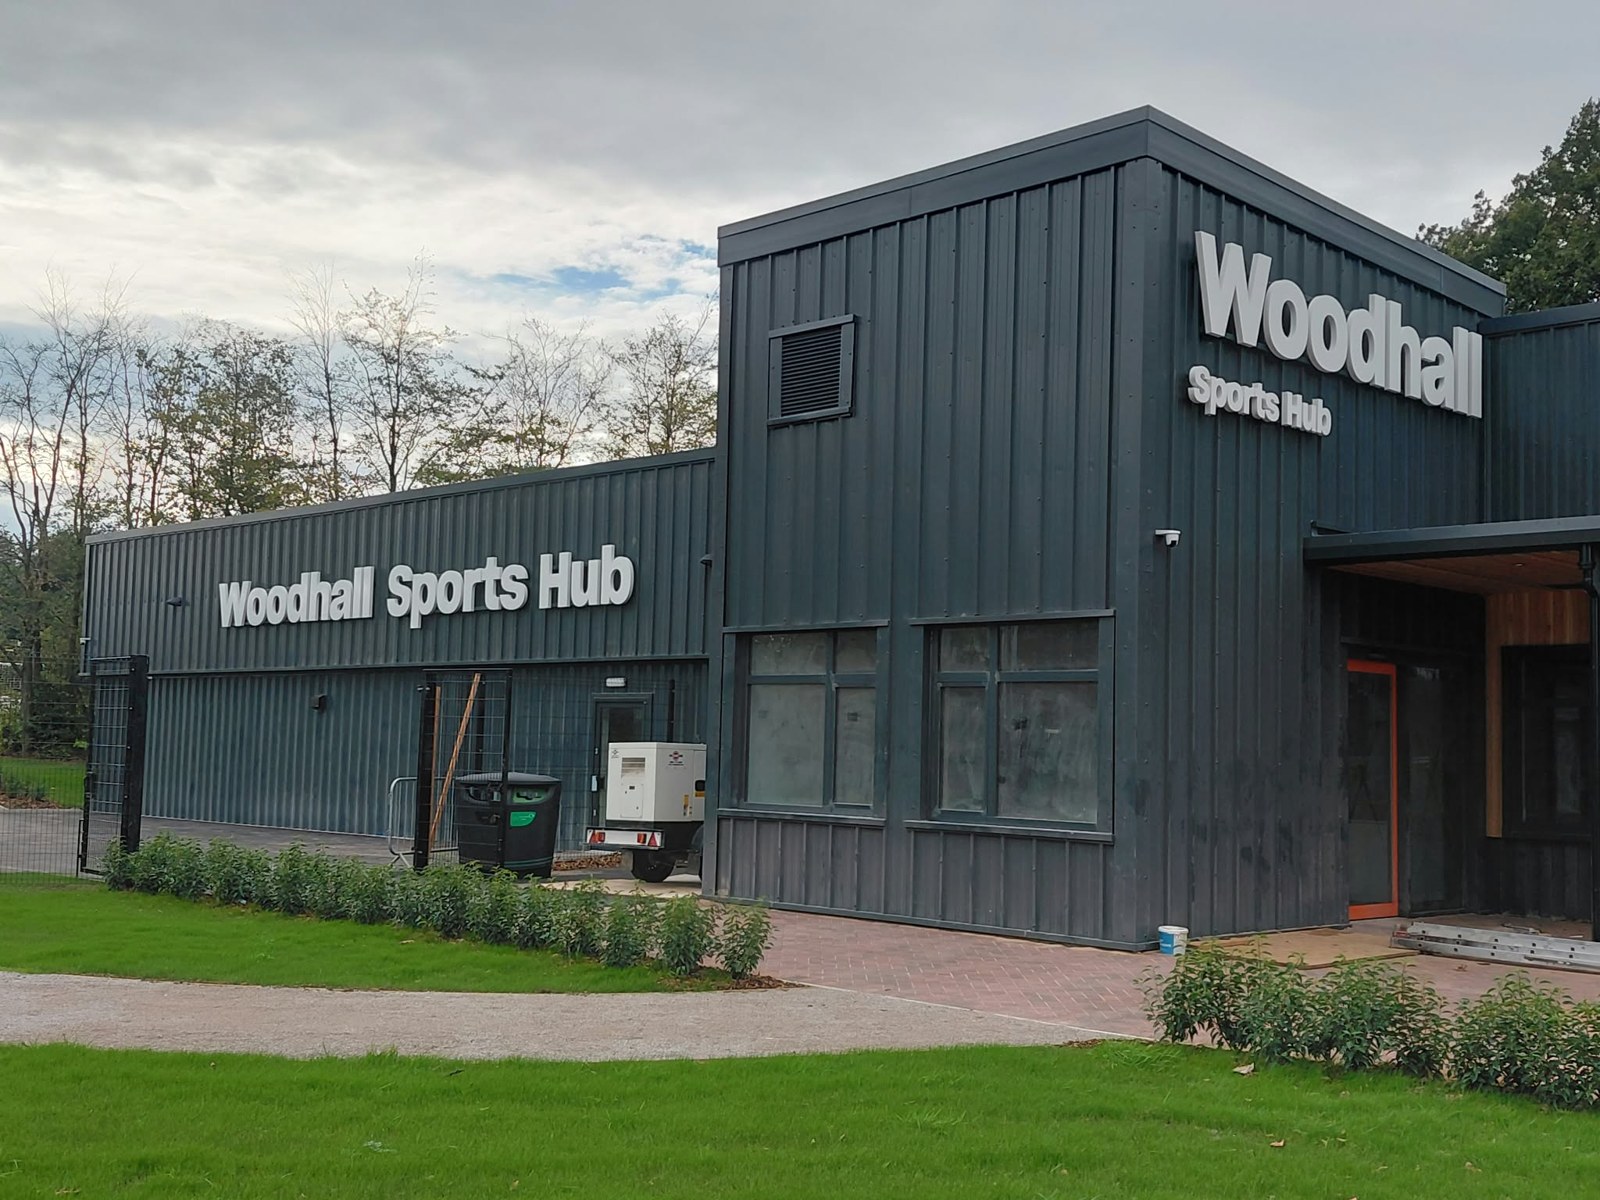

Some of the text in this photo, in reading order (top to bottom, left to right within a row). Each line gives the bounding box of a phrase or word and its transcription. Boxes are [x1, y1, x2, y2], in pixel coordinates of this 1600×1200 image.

[1195, 230, 1482, 418] Woodhall
[1187, 365, 1332, 436] Sports Hub
[219, 544, 635, 629] Woodhall Sports Hub
